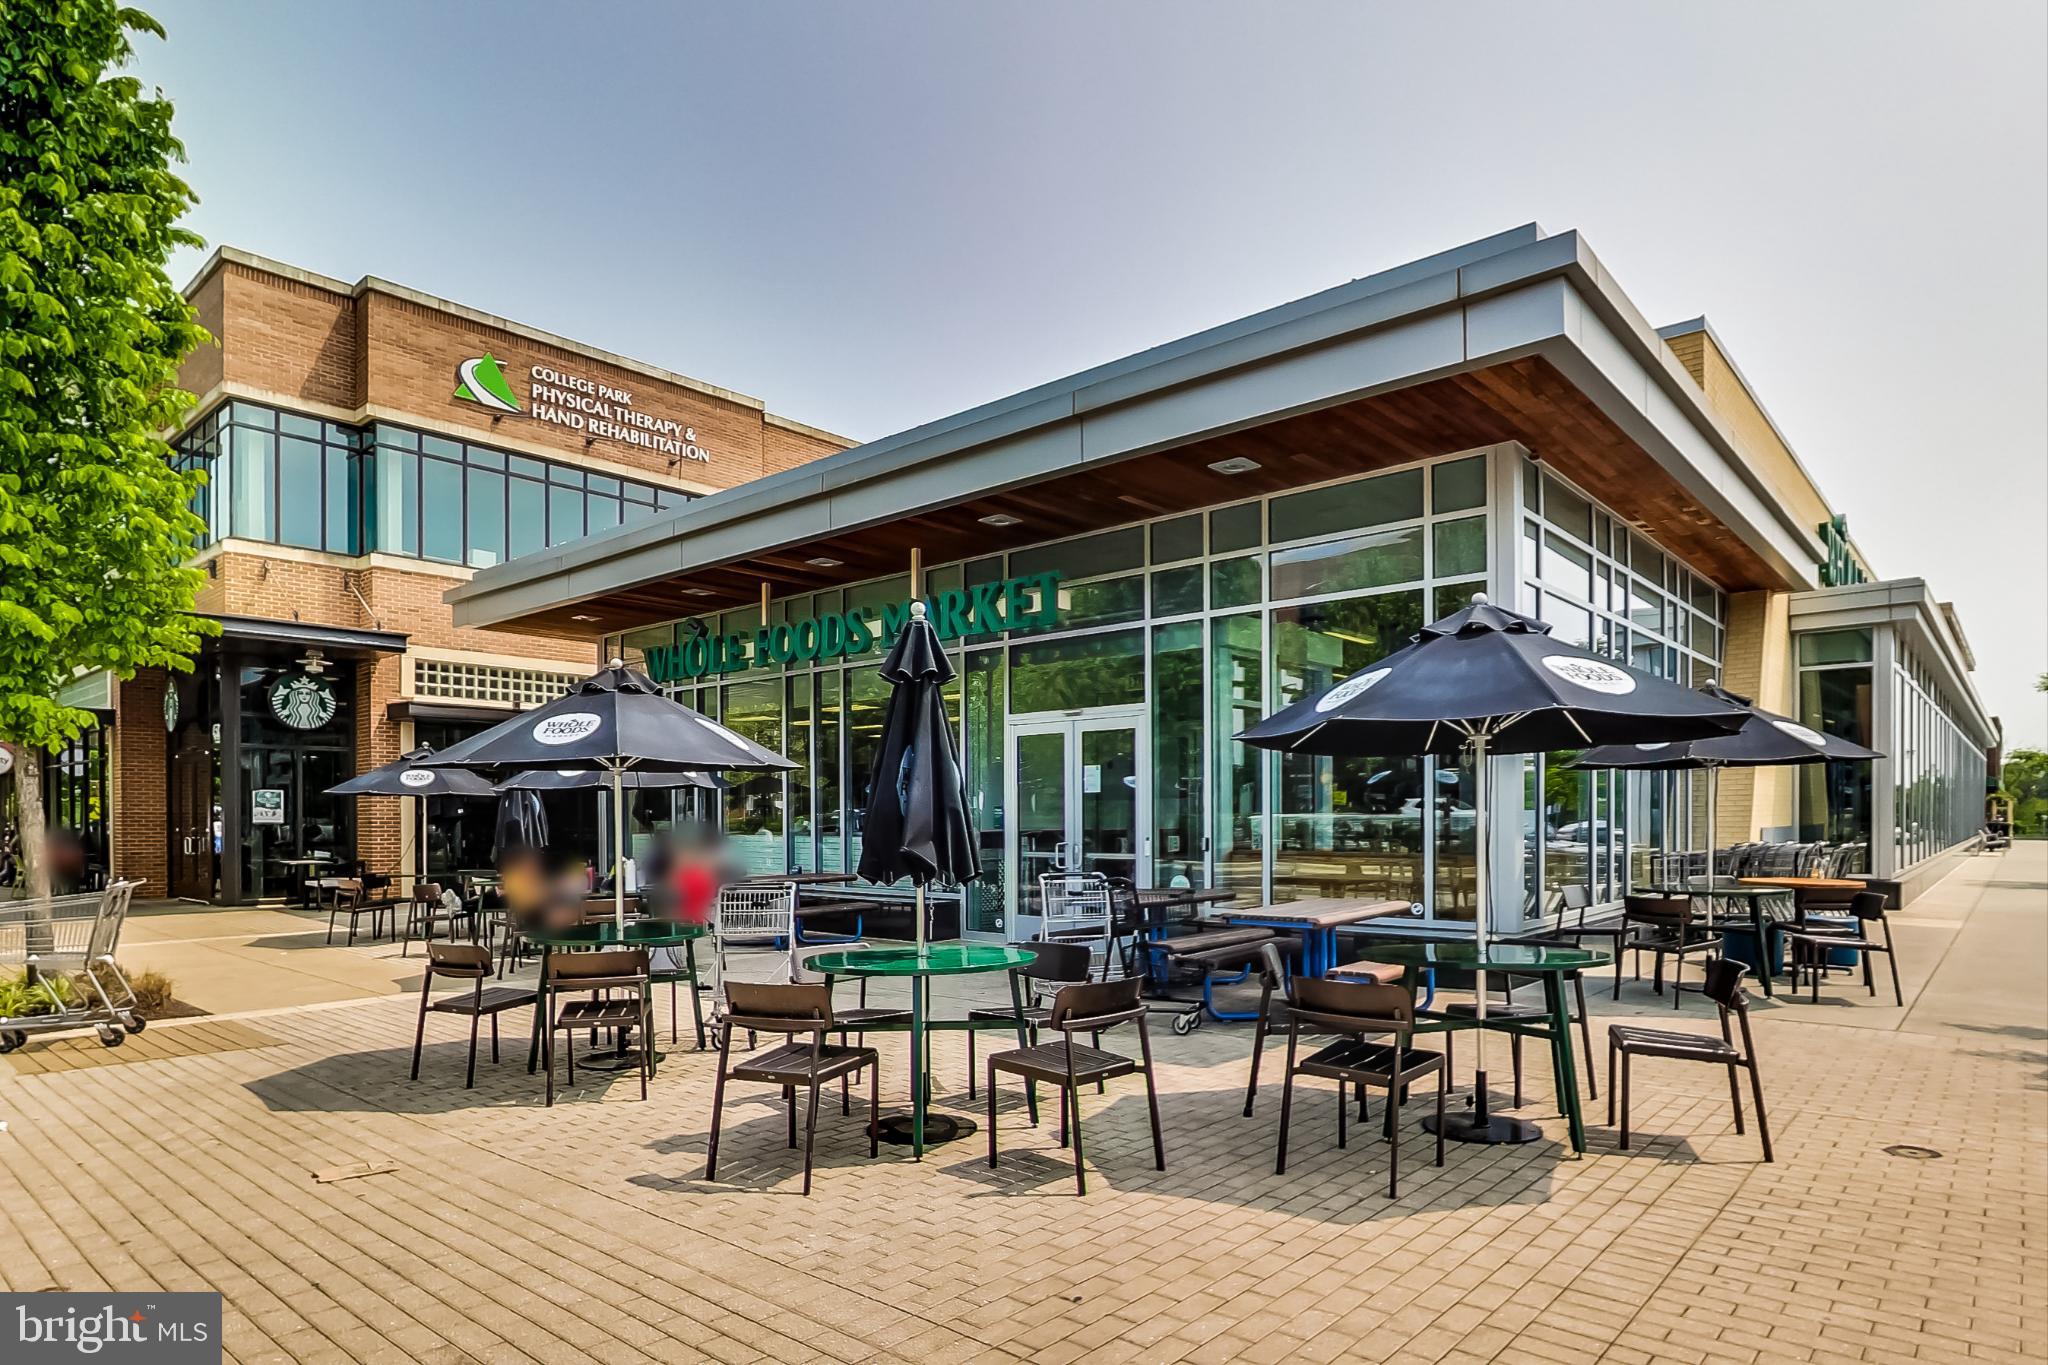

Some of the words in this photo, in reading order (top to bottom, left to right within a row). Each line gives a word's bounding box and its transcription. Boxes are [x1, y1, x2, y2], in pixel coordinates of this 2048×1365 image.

[531, 365, 595, 395] COLLEGE
[598, 384, 633, 406] PARK
[532, 383, 613, 419] PHYSICAL
[614, 406, 682, 437] THERAPY
[685, 427, 697, 442] &
[532, 403, 585, 429] HAND
[588, 417, 711, 463] REHABILITATION
[643, 629, 750, 683] WHOLE
[753, 608, 875, 668] FOODS
[543, 726, 590, 735] FOODS
[547, 719, 597, 728] WHOLE
